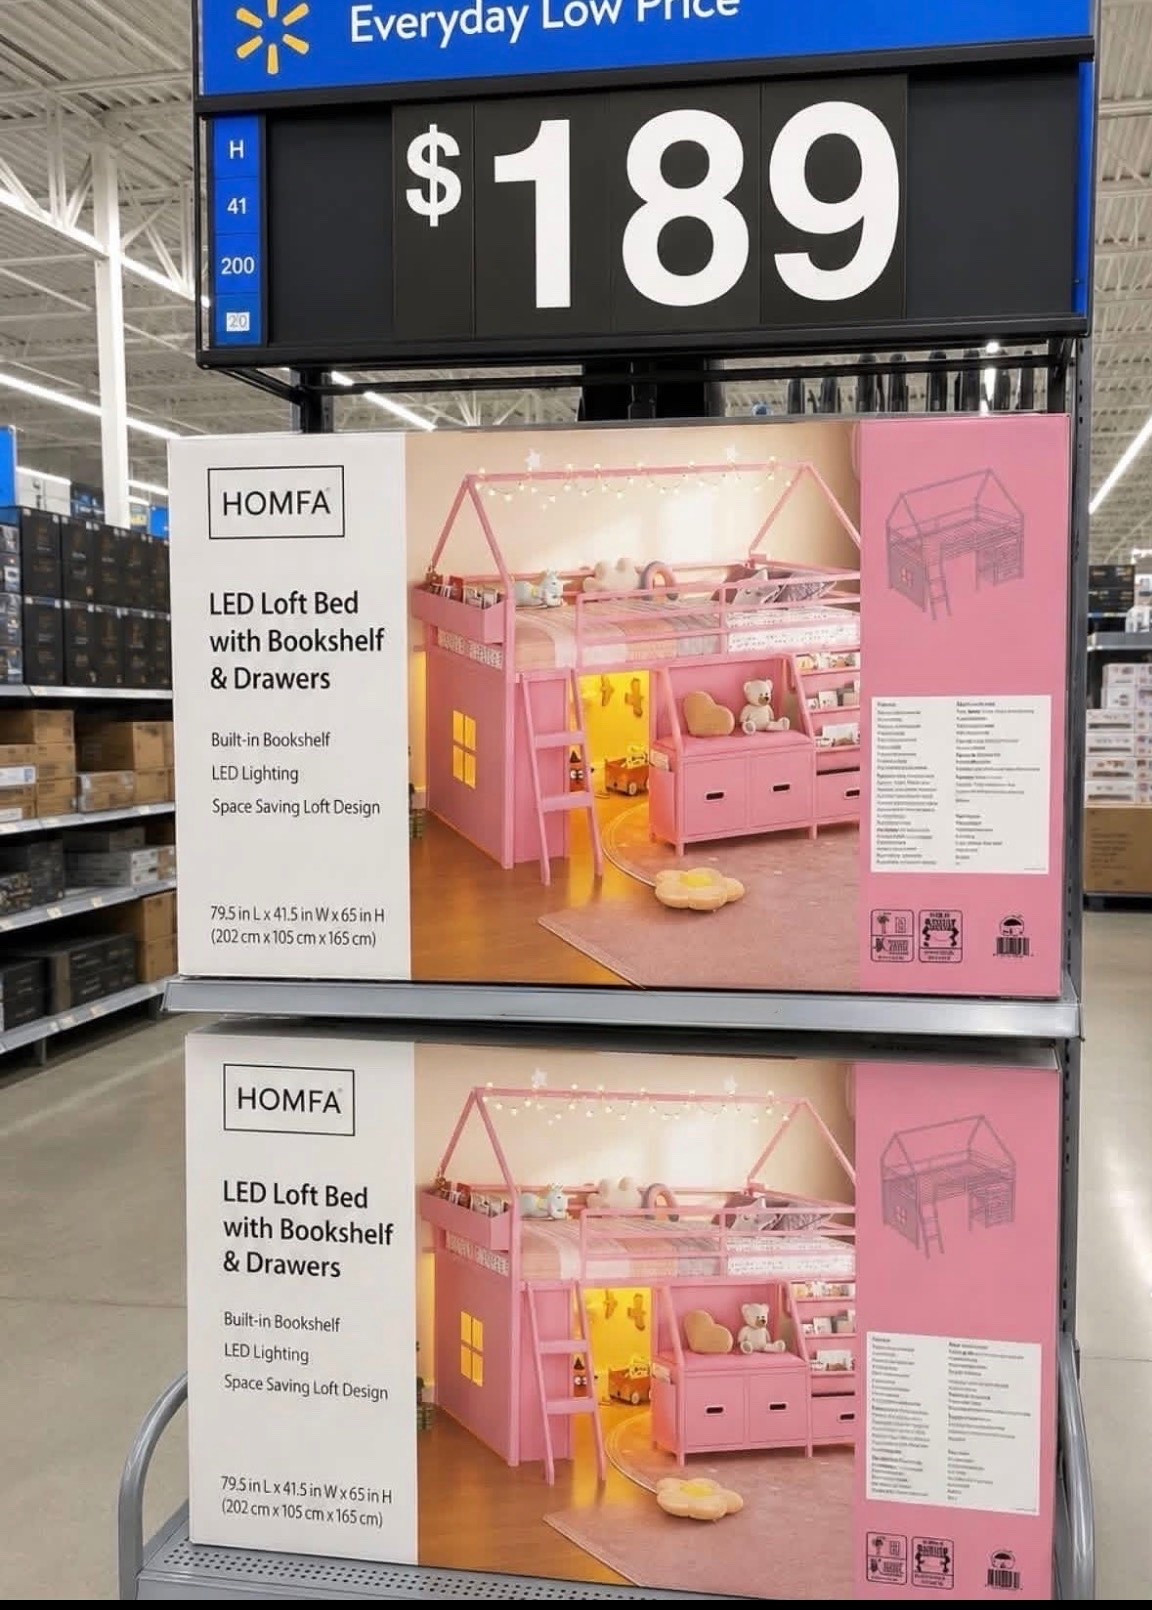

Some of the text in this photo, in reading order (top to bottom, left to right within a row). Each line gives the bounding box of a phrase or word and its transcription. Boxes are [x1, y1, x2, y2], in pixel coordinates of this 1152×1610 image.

[352, 0, 529, 48] Everyday
[543, 0, 622, 29] Low
[230, 140, 243, 159] H
[228, 198, 246, 214] 41
[405, 101, 901, 309] $189
[222, 257, 254, 274] 200
[222, 490, 330, 516] HOMFA
[210, 591, 358, 615] LED Loft Bed
[210, 628, 385, 652] with Bookshelf
[211, 667, 330, 689] & Drawers
[212, 732, 330, 747] Built-in Bookshelf
[213, 765, 298, 784] LED Lighting
[213, 798, 380, 818] Space Saving Loft Design
[211, 906, 384, 922] 79.5 in L x 41.5 in W x 65 in H
[211, 929, 376, 947] (202 cm x 105 cm x 165 cm)
[238, 1087, 341, 1114] HOMFA
[224, 1180, 367, 1208] LED Loft Bed
[224, 1216, 393, 1245] with Bookshelf
[224, 1250, 340, 1277] & Drawers
[224, 1311, 340, 1332] Built-in Bookshelf
[225, 1343, 309, 1365] LED Lighting
[225, 1374, 388, 1402] Space Saving Loft Design
[221, 1476, 391, 1503] 79.5 in L x 41.5 in W x 65 in H
[222, 1498, 382, 1528] (202 cm x 105 cm x 165 cm)
